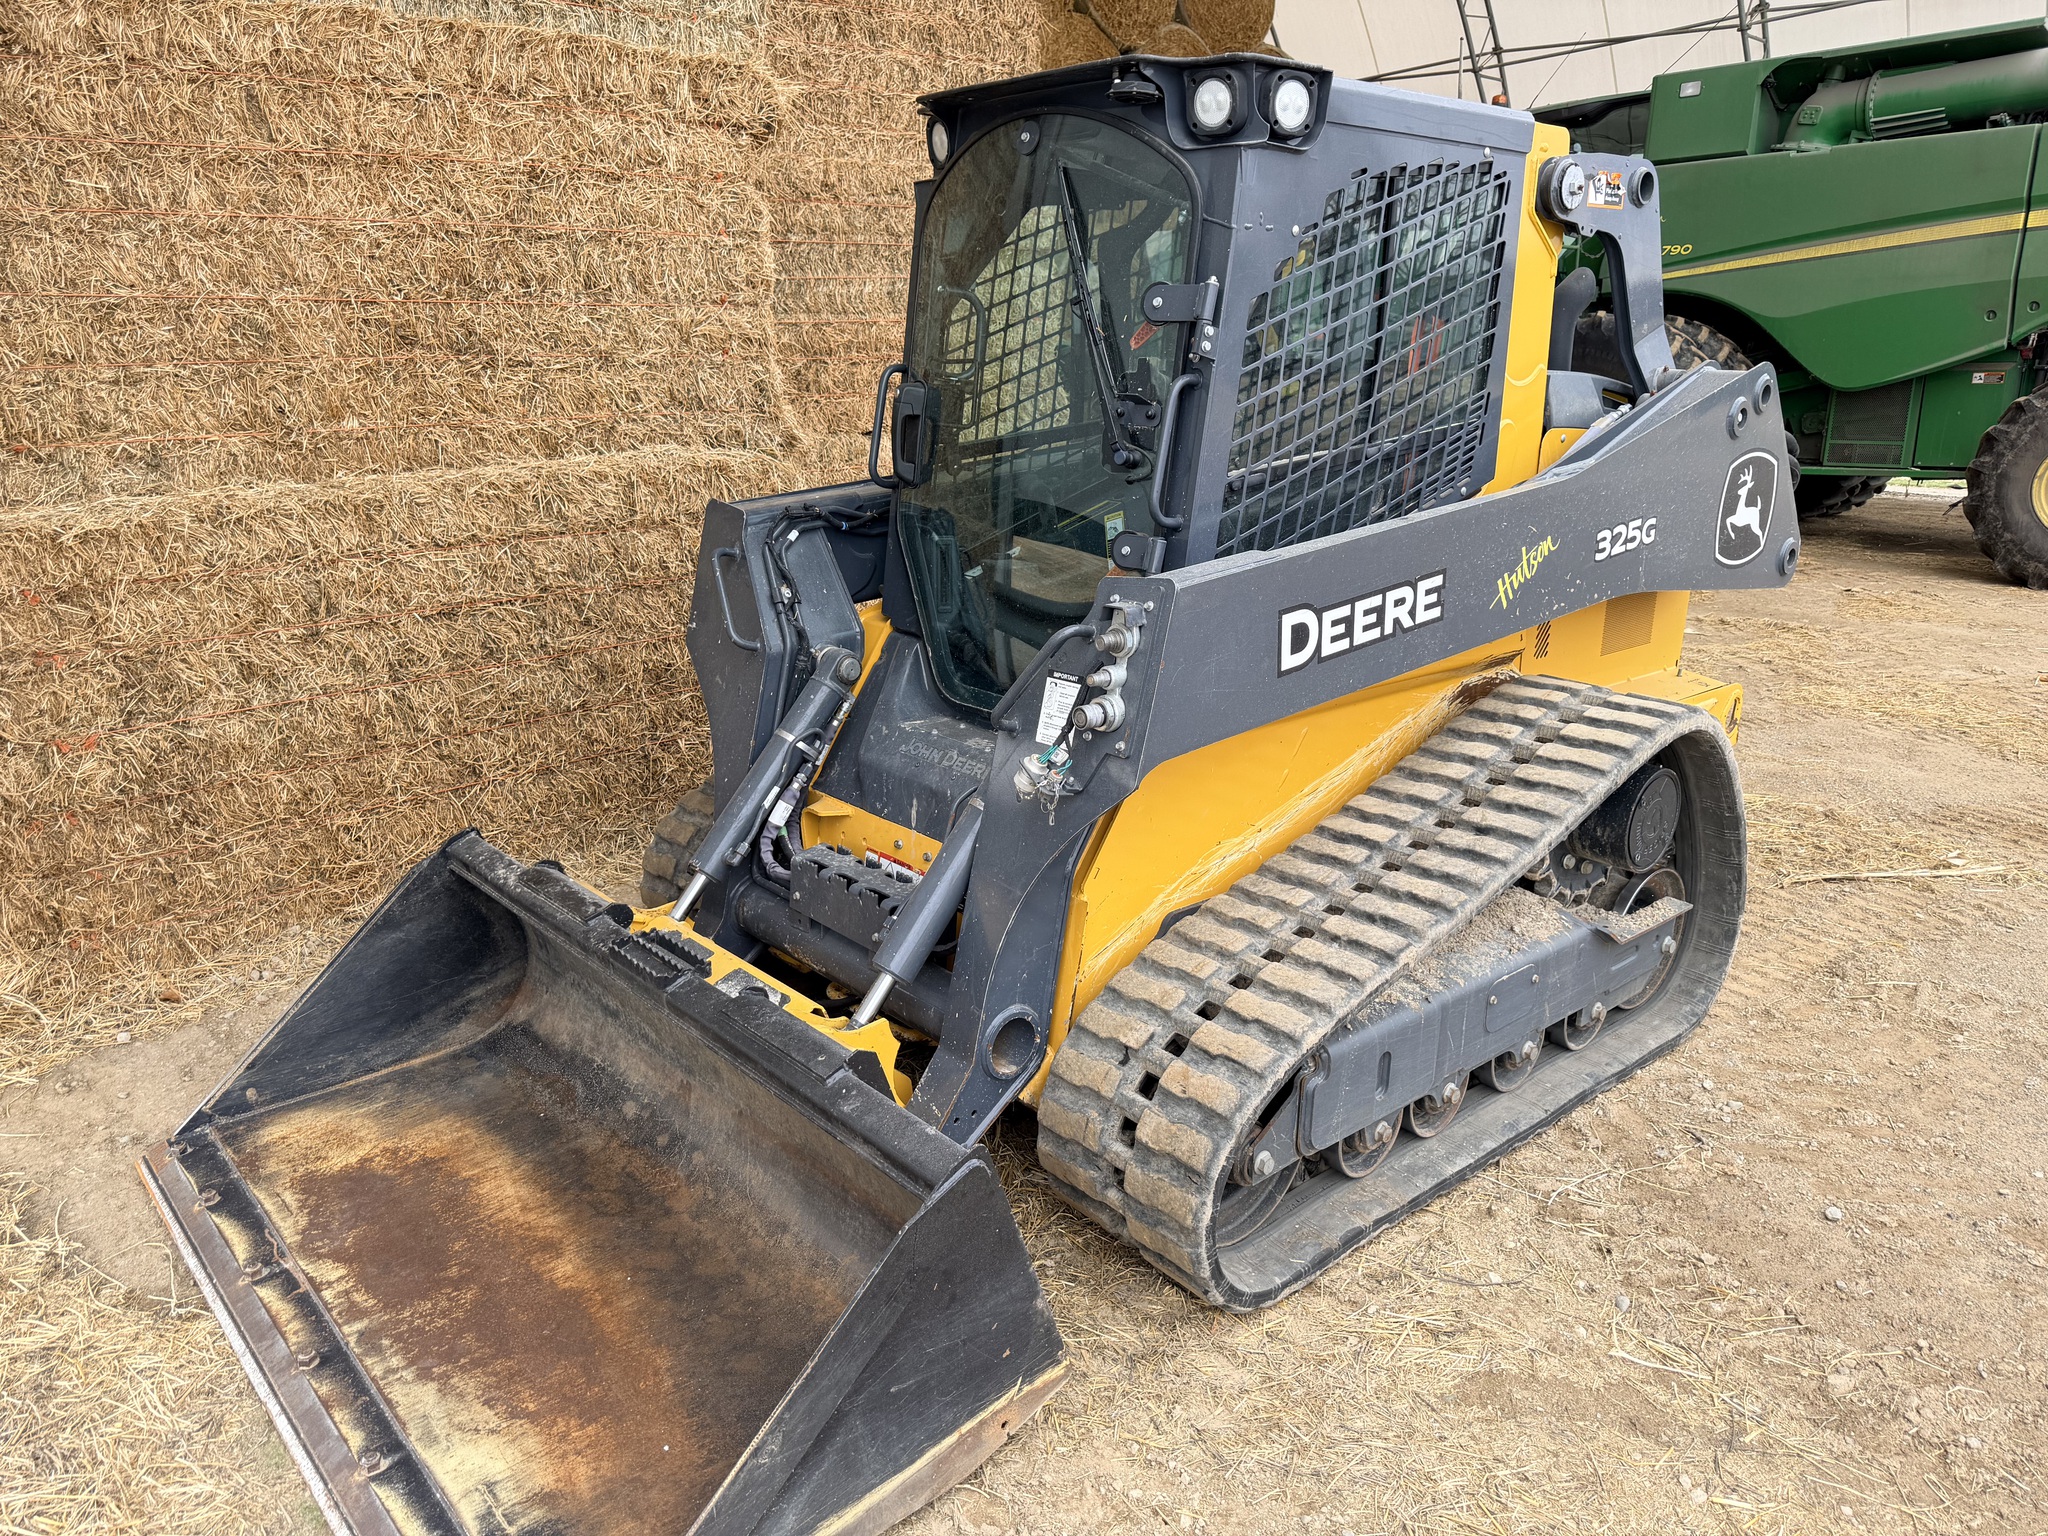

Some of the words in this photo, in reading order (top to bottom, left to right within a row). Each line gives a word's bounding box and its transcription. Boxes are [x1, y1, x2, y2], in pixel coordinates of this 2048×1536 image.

[1661, 244, 1693, 256] 790
[1593, 517, 1657, 562] 325G
[1489, 535, 1561, 609] Hutson
[1281, 573, 1444, 672] DEERE
[1053, 671, 1079, 683] IMPORTANT
[899, 738, 944, 763] JOHN
